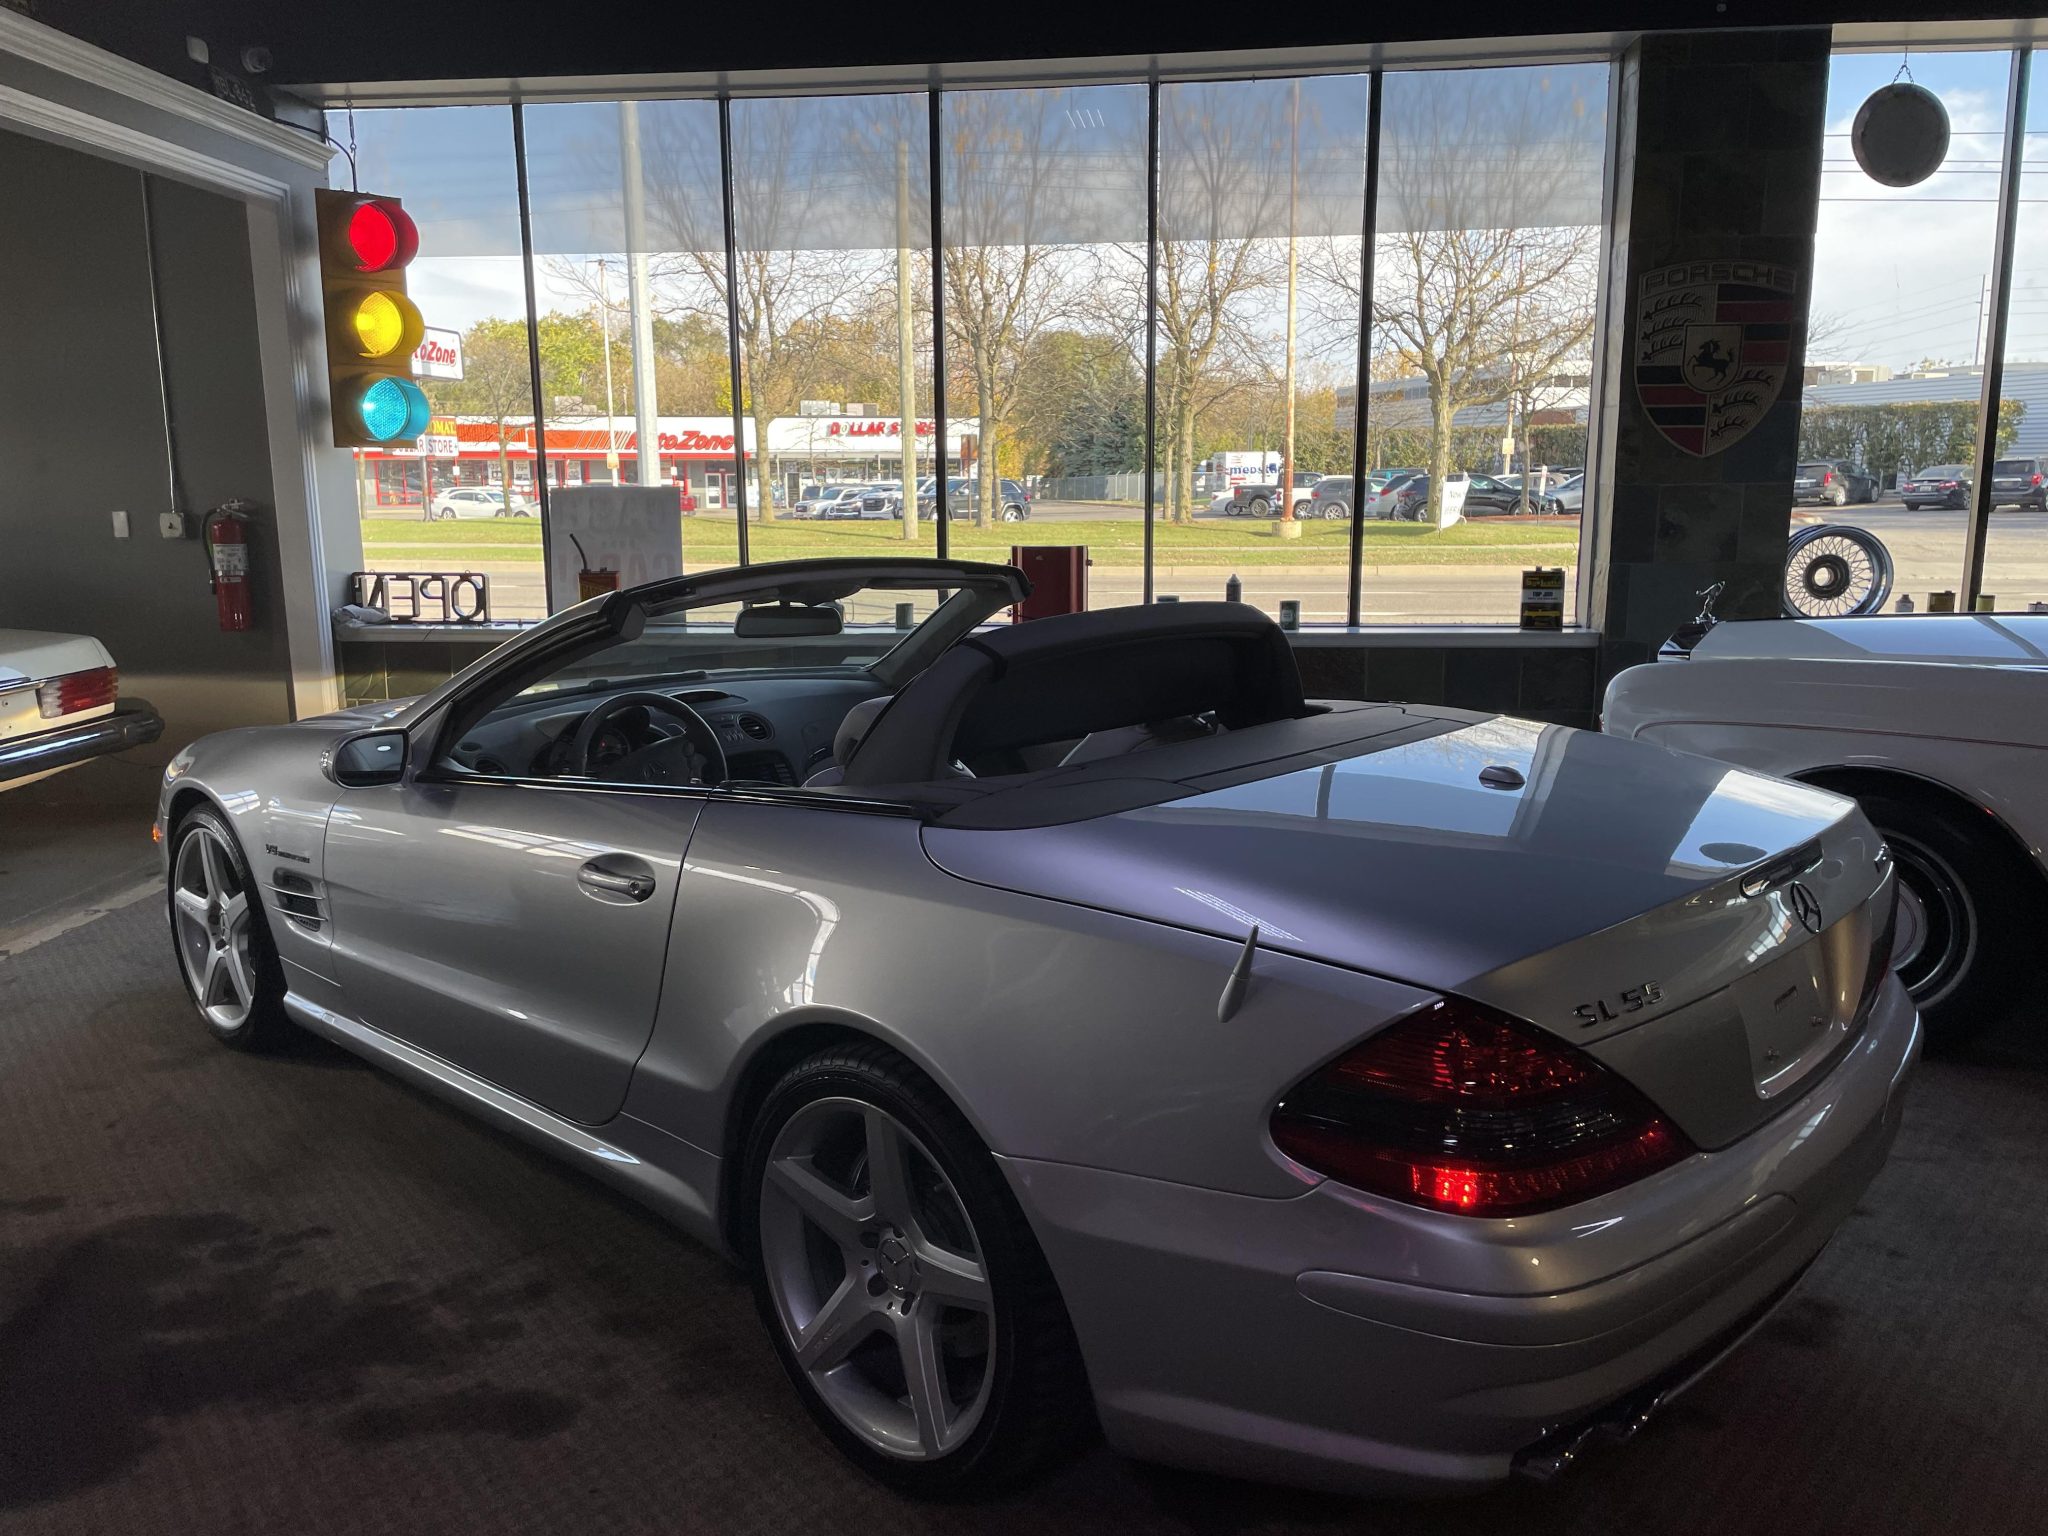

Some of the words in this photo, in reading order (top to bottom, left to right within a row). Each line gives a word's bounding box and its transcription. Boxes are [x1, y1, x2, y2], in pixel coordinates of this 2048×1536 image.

[1645, 261, 1794, 294] PORSCHE
[624, 430, 735, 450] AtoZone
[829, 421, 885, 436] DOLLAR
[888, 421, 935, 436] SRE
[1572, 1000, 1619, 1029] SL
[1621, 981, 1665, 1013] 55
